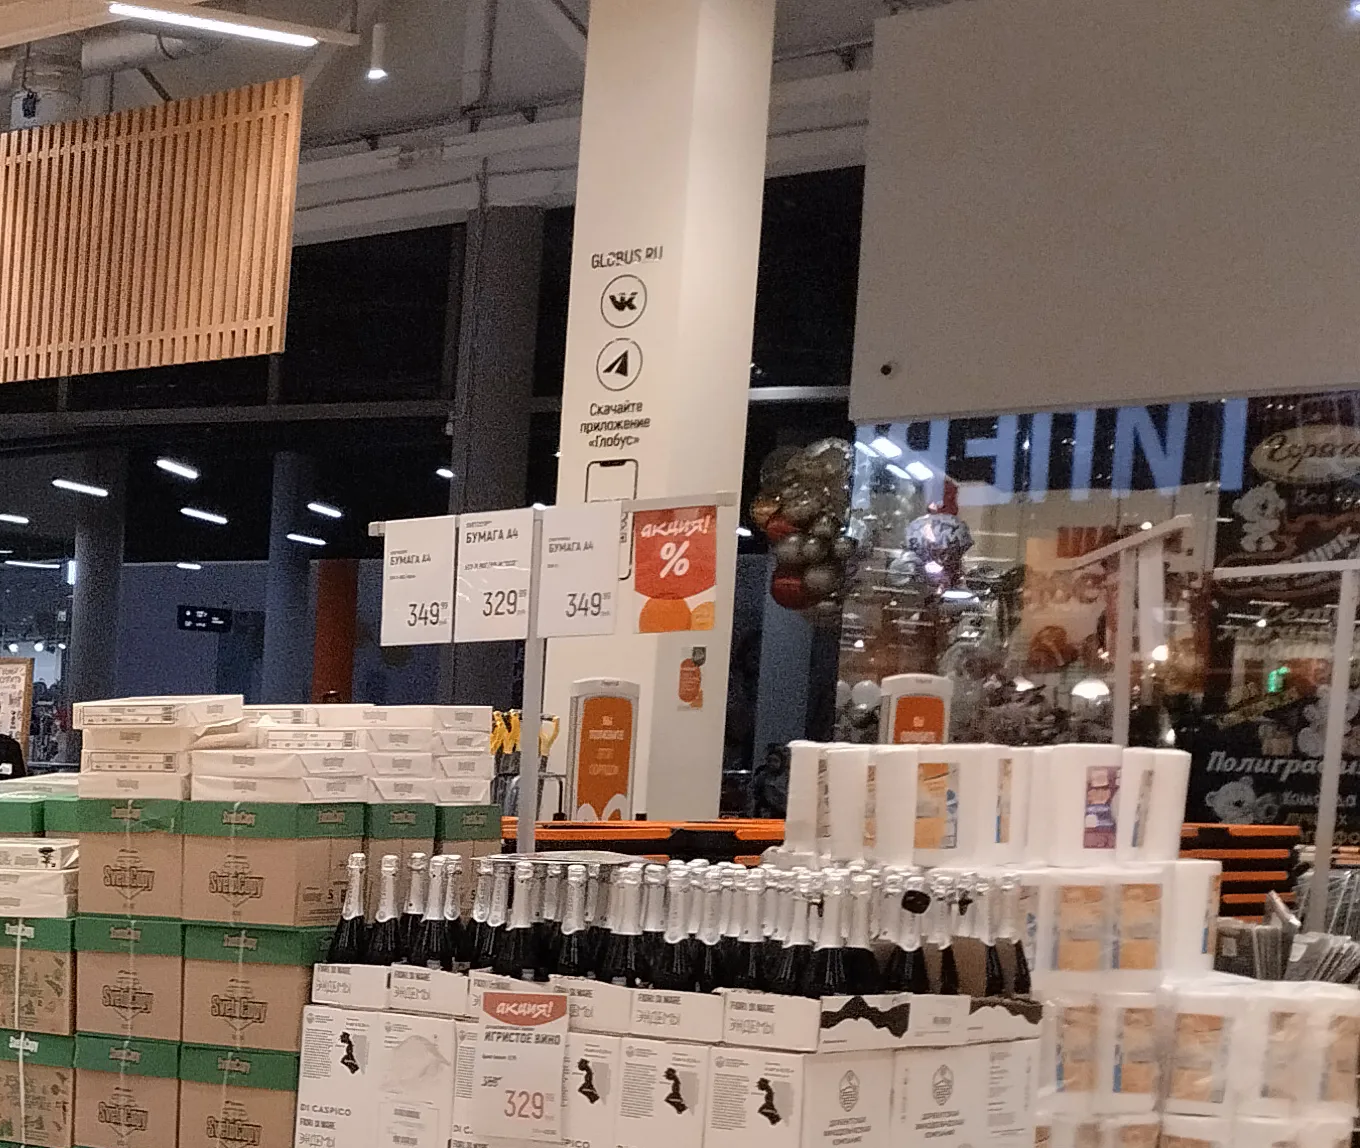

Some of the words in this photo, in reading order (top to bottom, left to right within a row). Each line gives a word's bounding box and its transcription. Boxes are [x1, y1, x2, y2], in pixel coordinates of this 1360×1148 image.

[589, 399, 643, 417] Скачайте
[579, 417, 652, 434] приложение
[588, 433, 640, 450] «Глобус»
[466, 531, 506, 544] БУМАГА
[548, 541, 582, 554] БУМАГА
[389, 556, 421, 566] БУМАГА
[482, 589, 518, 618] 329
[565, 591, 603, 619] 349
[407, 602, 441, 628] 349
[483, 1030, 533, 1045] ИГРИСТОЕ
[533, 1032, 562, 1046] ВИНО
[314, 1104, 352, 1117] CASPICO
[503, 1089, 546, 1120] 329
